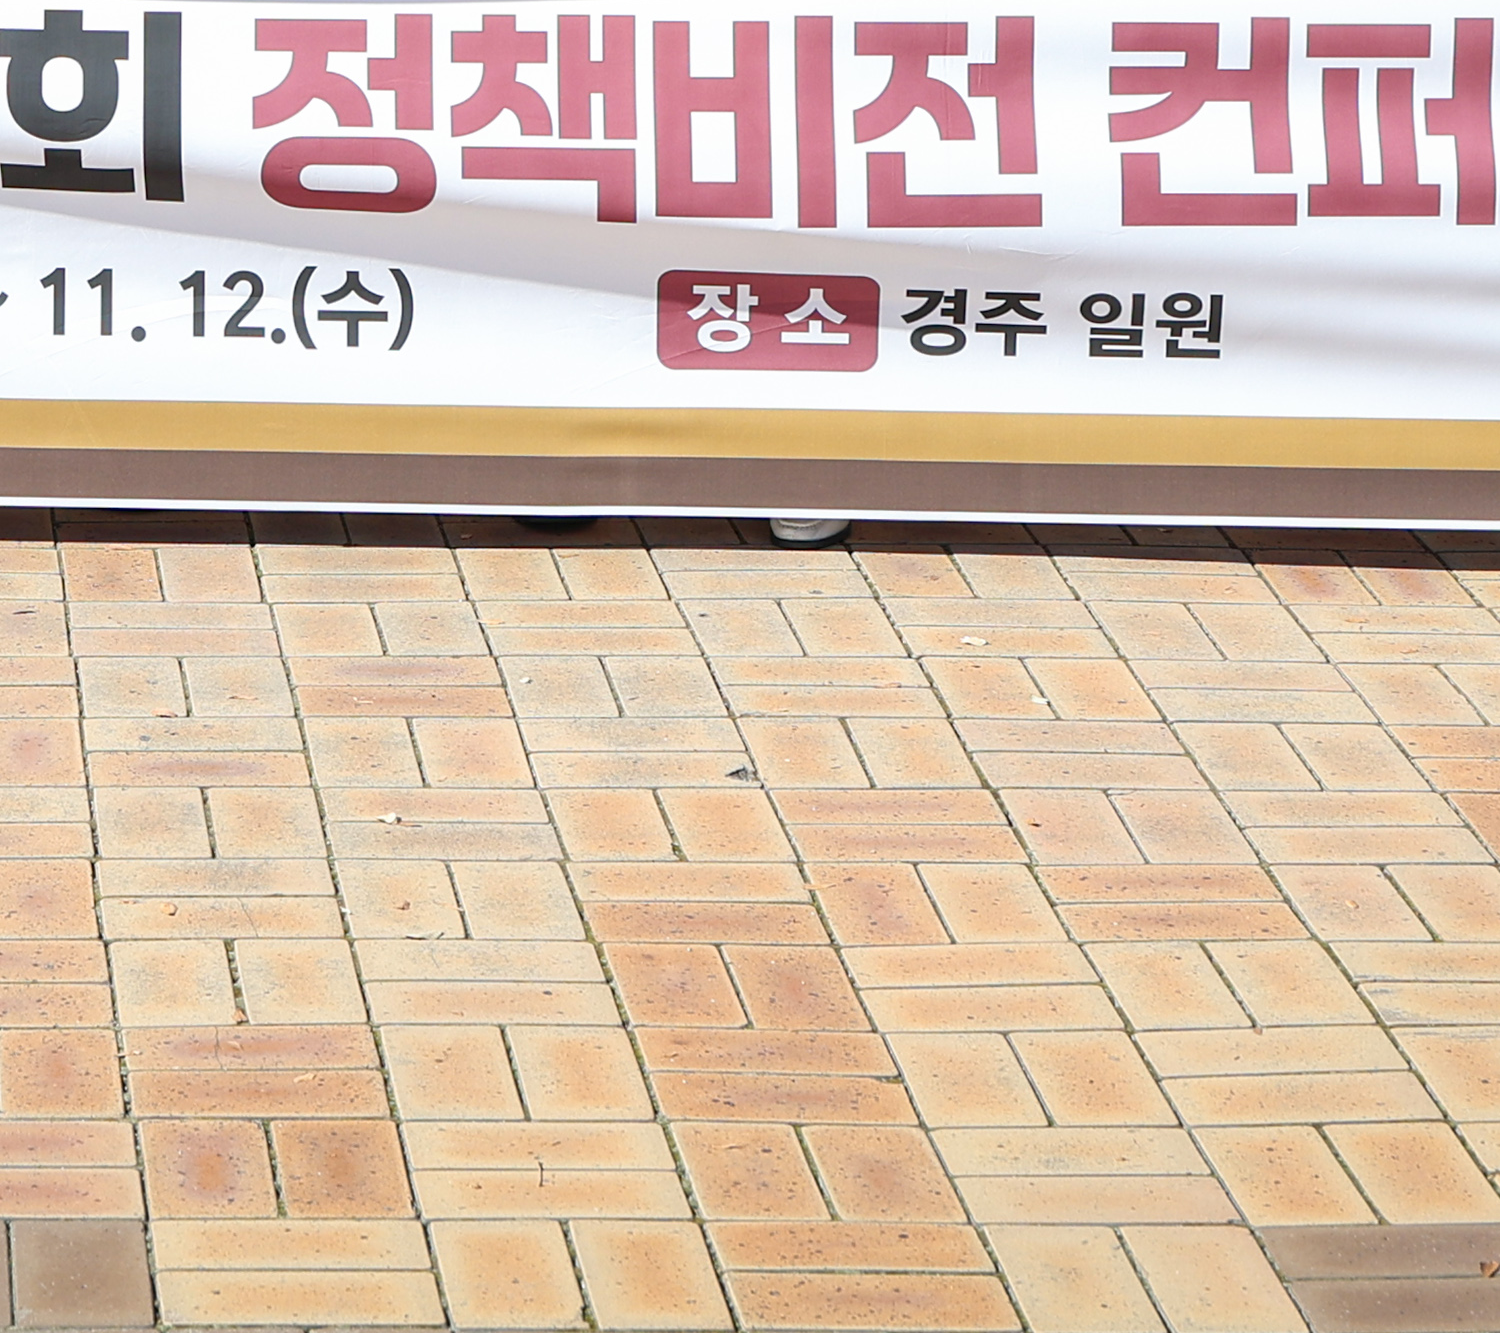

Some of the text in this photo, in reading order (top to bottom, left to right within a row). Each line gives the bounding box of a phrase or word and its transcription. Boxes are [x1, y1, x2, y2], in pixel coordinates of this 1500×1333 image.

[261, 16, 1042, 227] 정책비전
[41, 268, 145, 341] 11.
[180, 266, 413, 350] 12.(수)
[901, 289, 1223, 358] 경주 일원
